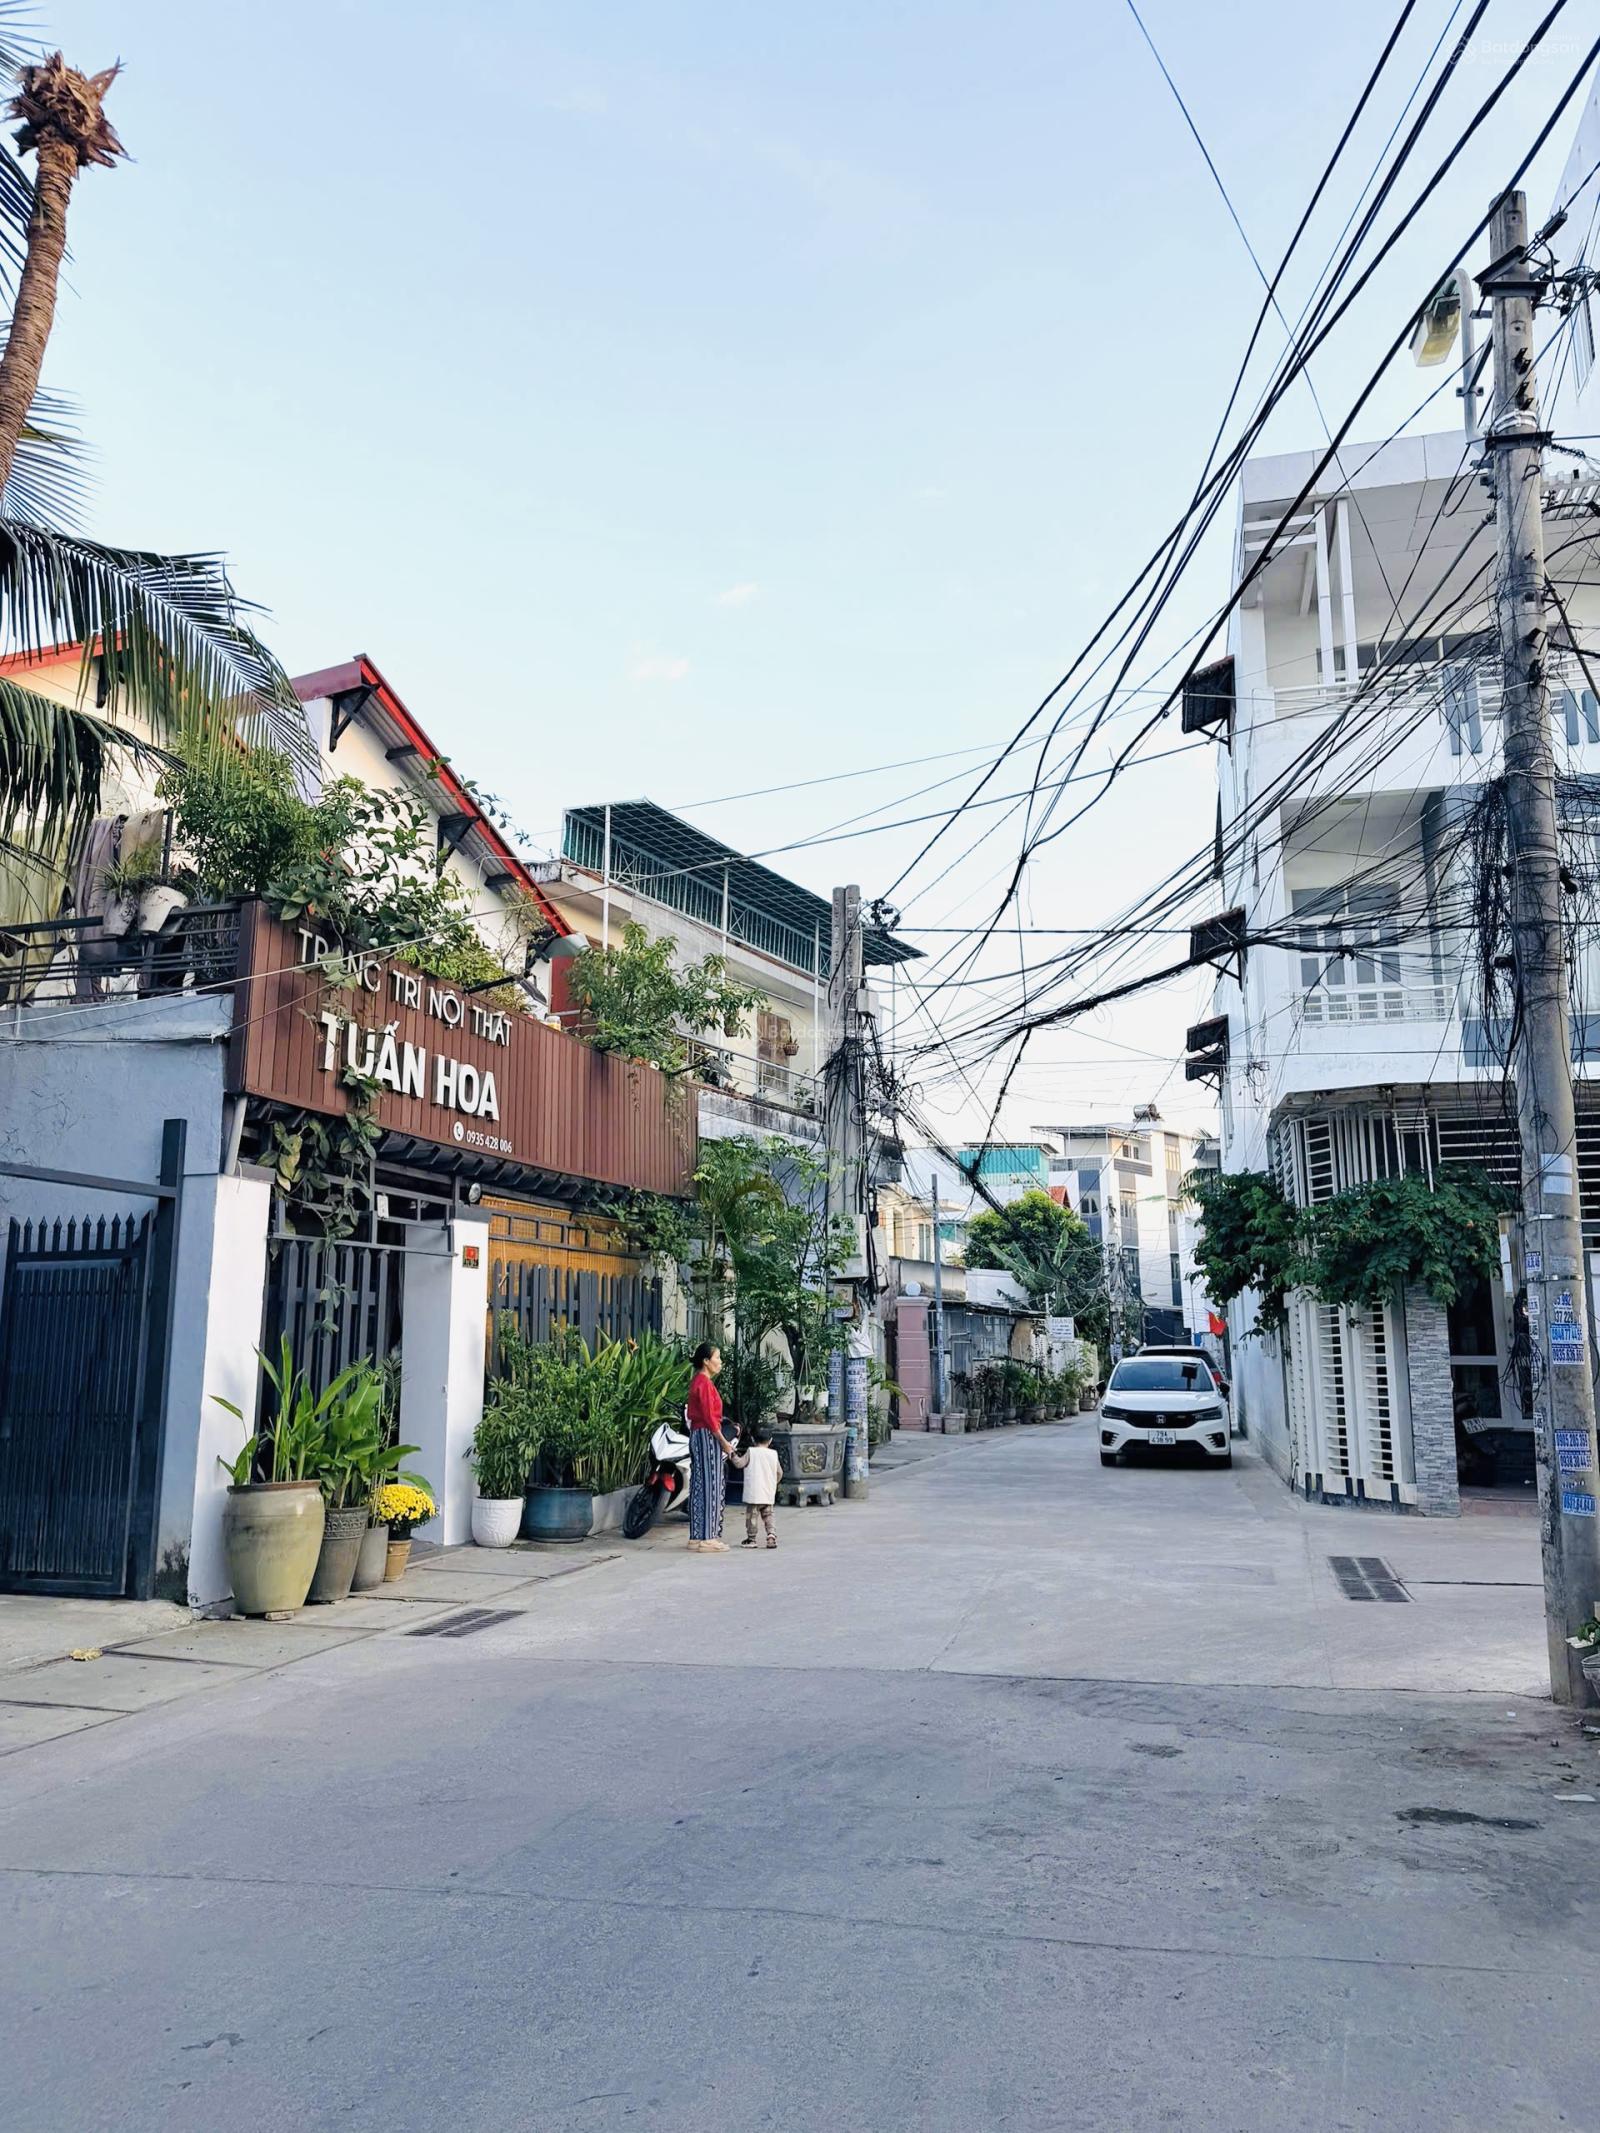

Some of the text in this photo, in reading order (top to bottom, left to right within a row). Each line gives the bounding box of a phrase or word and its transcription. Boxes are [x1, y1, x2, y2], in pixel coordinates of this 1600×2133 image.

[298, 928, 513, 1048] TRNG TRÍ NỘI THẤT
[318, 1012, 500, 1122] TUẤN HOA
[466, 1129, 513, 1154] 0935 428 006
